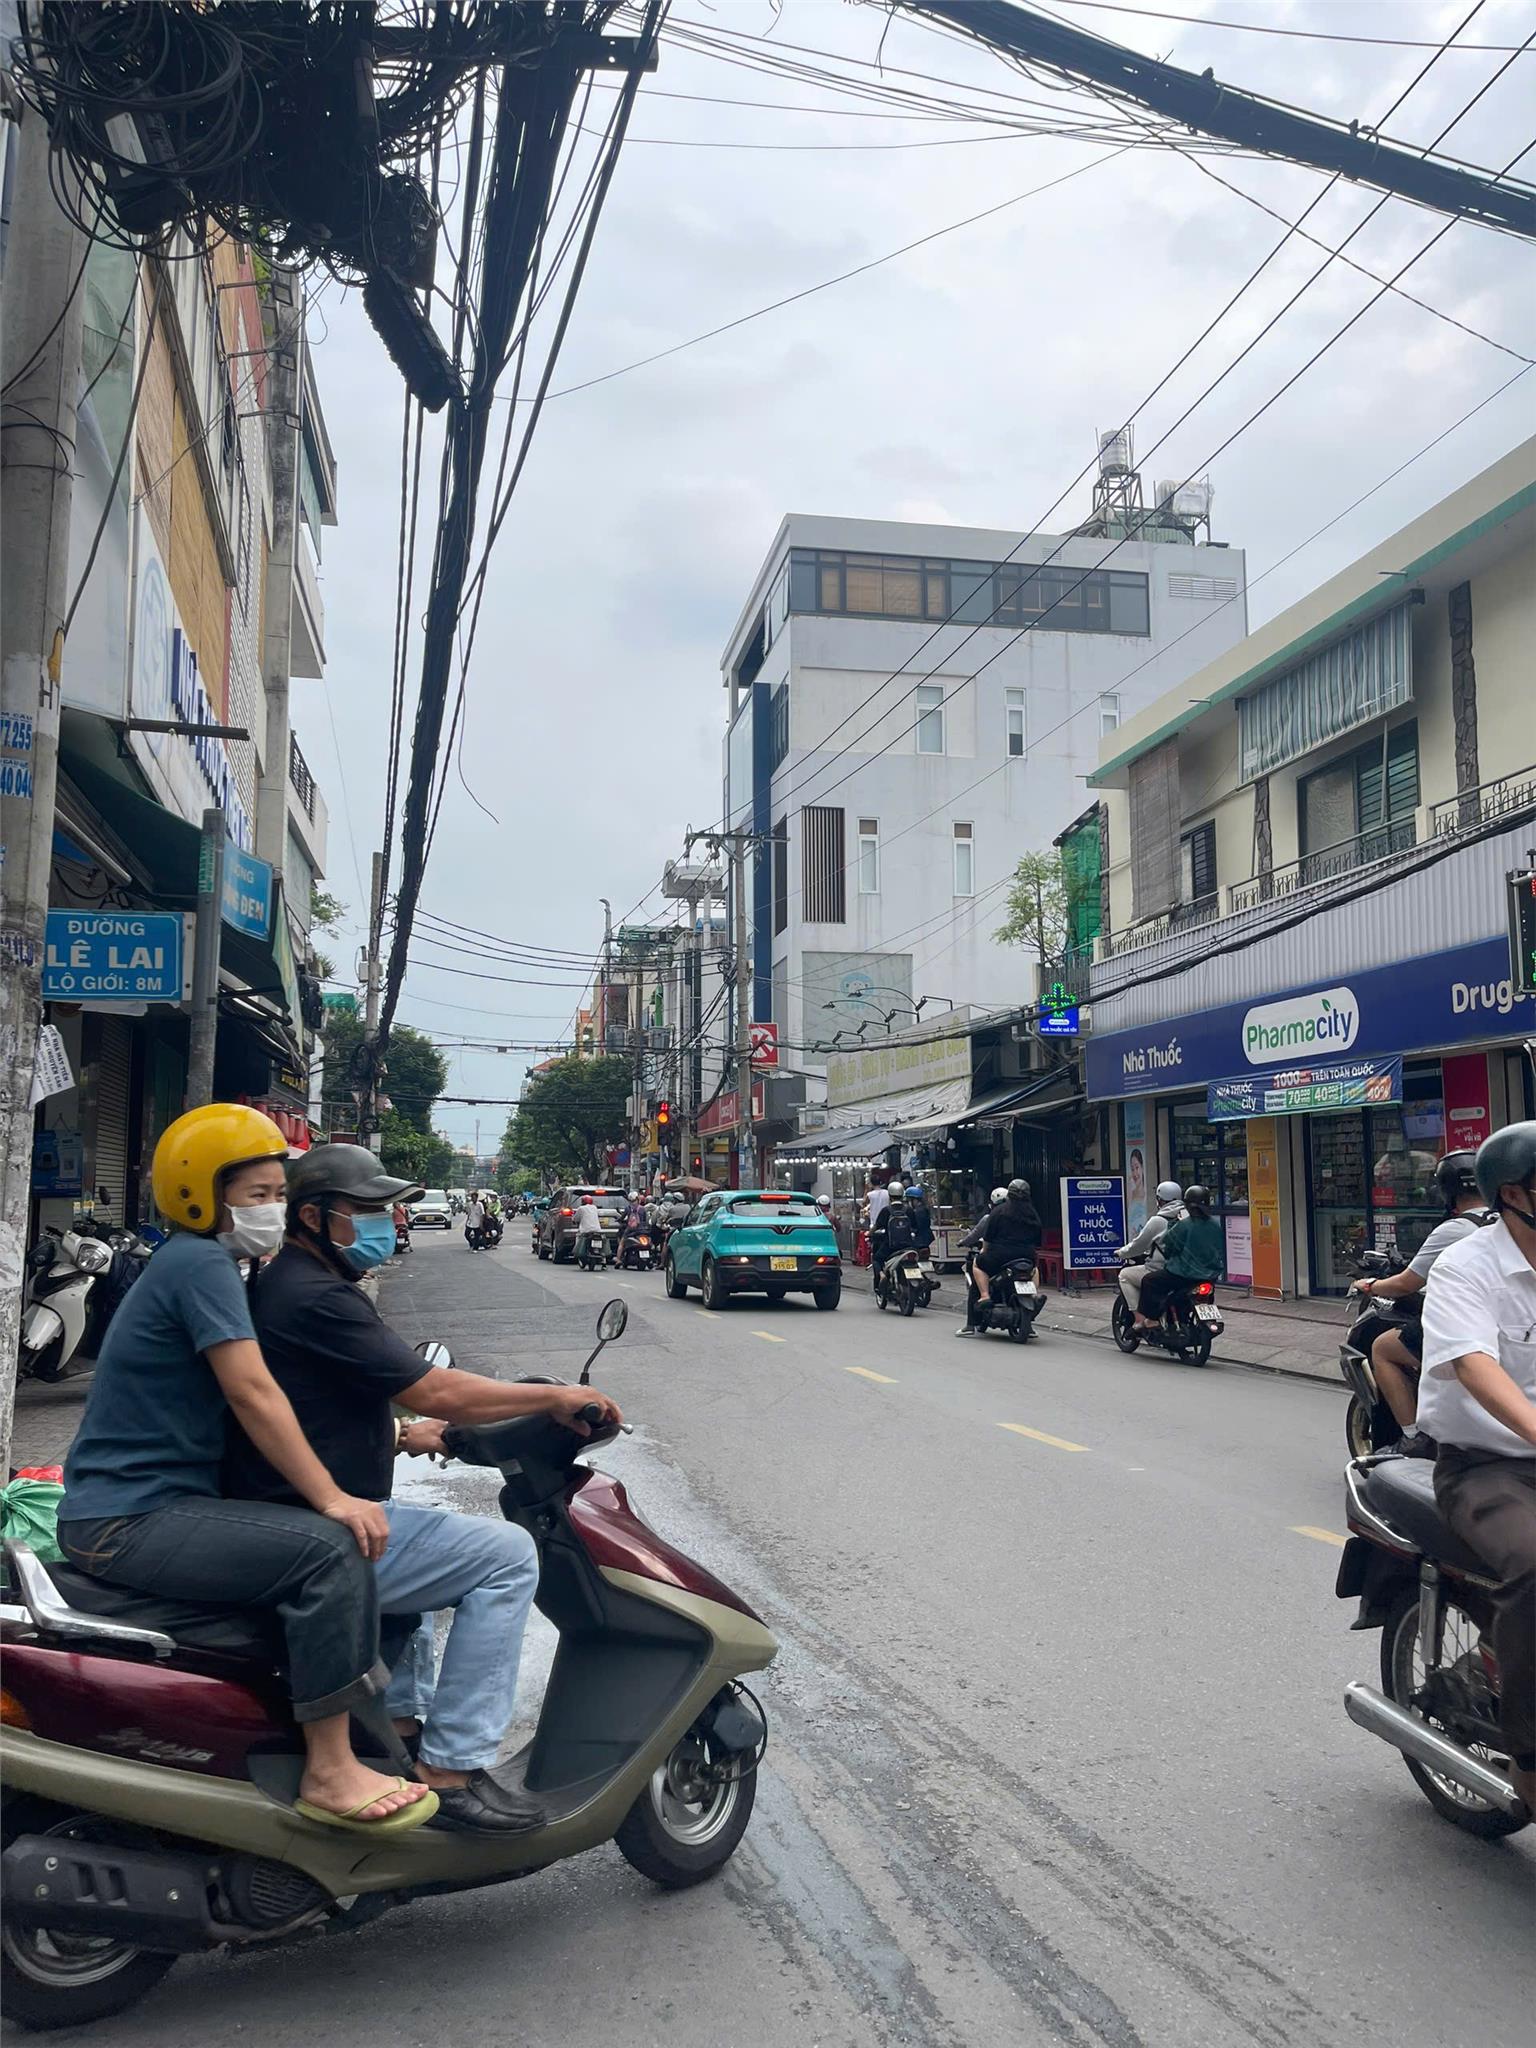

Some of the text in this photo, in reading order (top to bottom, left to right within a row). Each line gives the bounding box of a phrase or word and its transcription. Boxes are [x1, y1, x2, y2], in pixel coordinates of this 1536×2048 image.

[67, 917, 145, 936] ĐƯỜNG
[47, 939, 91, 968] LÊ
[108, 946, 164, 969] LAI
[48, 971, 163, 992] LỘ GIỚI: 8M
[1452, 979, 1527, 1014] Drug
[1247, 1004, 1353, 1054] Pharmacity
[1123, 1037, 1182, 1074] Nhà Thuốc
[1084, 1202, 1106, 1214] NHÀ
[1079, 1215, 1113, 1228] THUỐC
[1078, 1229, 1112, 1243] GIÁ TỐ
